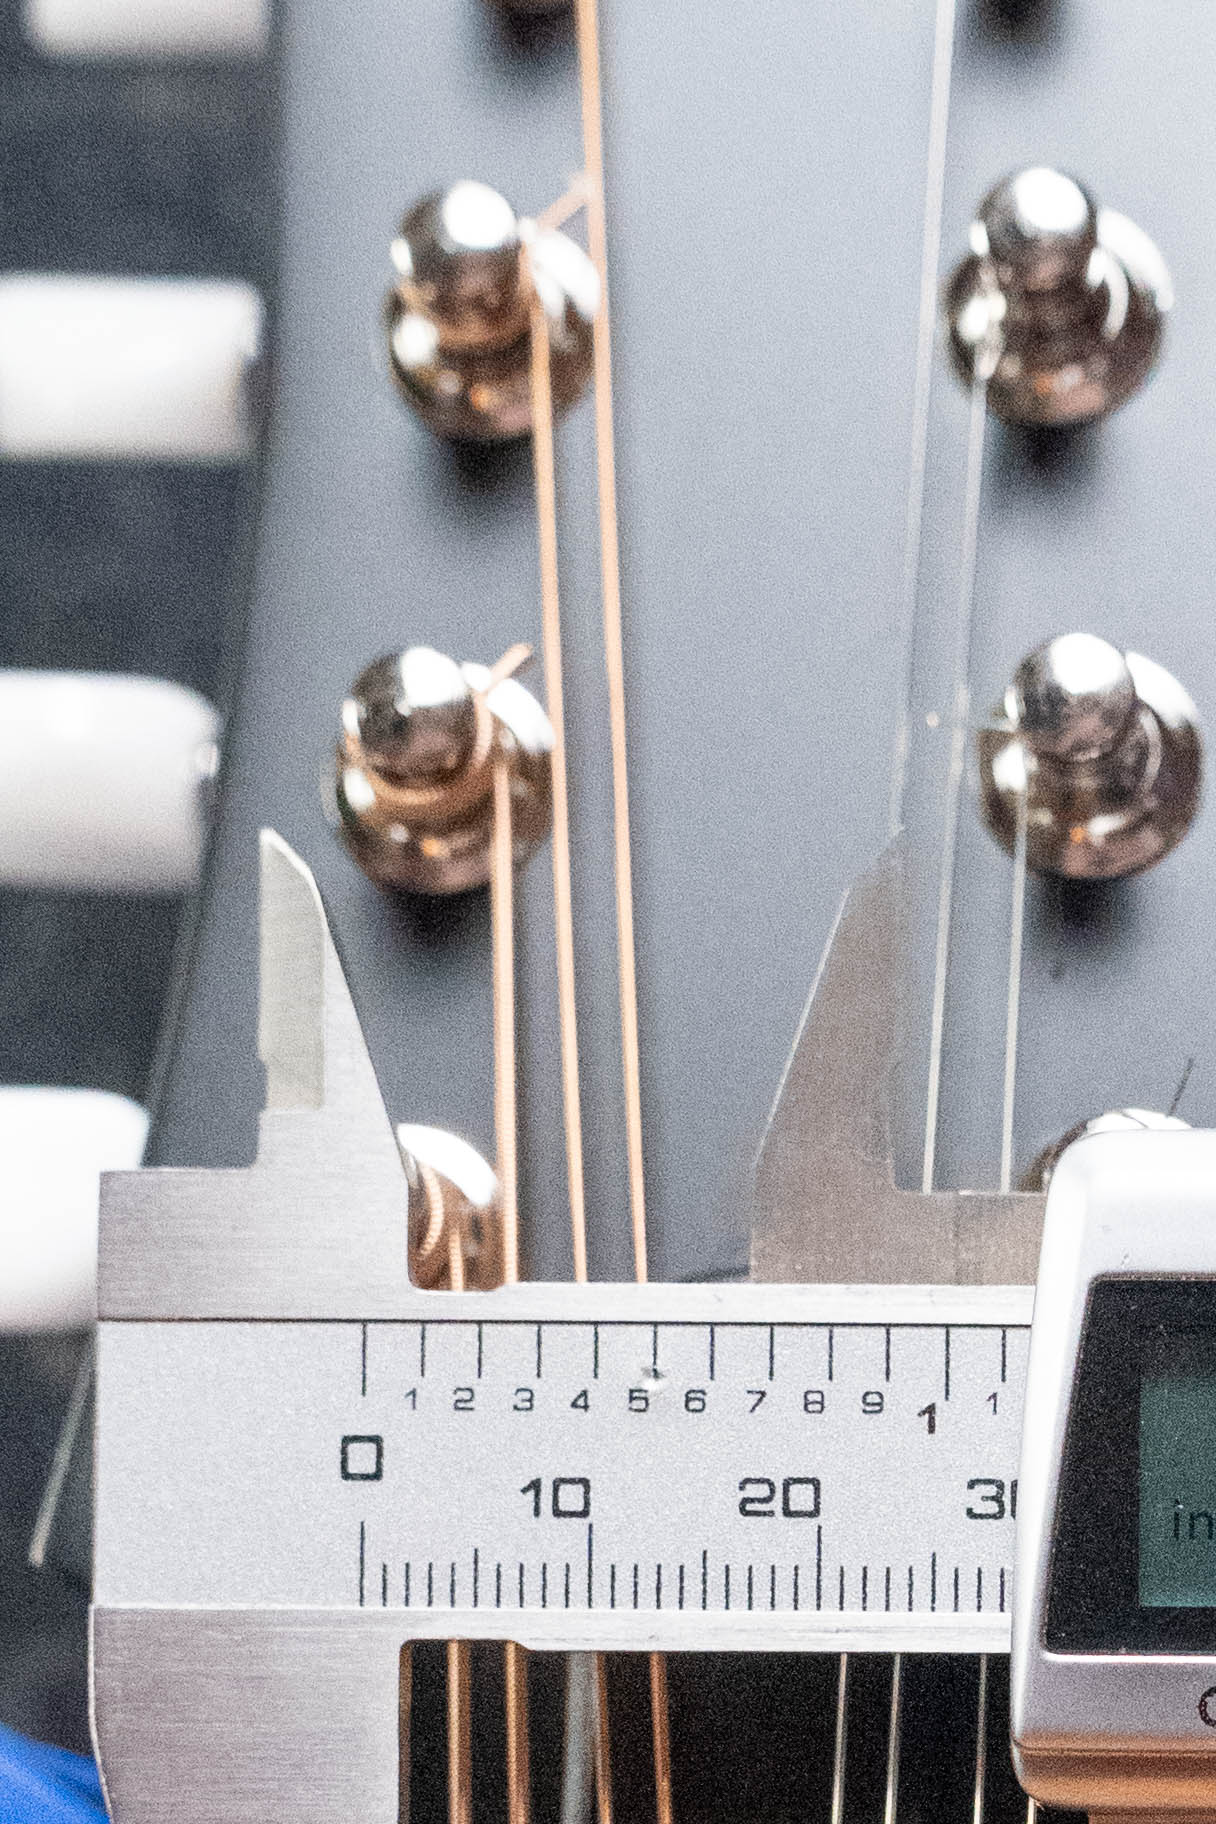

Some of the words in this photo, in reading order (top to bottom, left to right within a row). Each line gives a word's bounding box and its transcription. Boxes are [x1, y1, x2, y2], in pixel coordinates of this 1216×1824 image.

[404, 1388, 419, 1411] 1
[453, 1388, 476, 1411] 2
[513, 1388, 535, 1412] 3
[570, 1389, 591, 1413] 4
[628, 1389, 650, 1413] 5
[684, 1389, 708, 1413] 6
[746, 1389, 768, 1413] 7
[803, 1389, 826, 1414] 8
[861, 1389, 885, 1414] 9
[917, 1403, 937, 1434] 1
[985, 1392, 1000, 1415] 1
[340, 1435, 384, 1481] 0
[519, 1477, 592, 1519] 10
[737, 1477, 821, 1520] 20
[965, 1478, 1018, 1520] 3
[1171, 1501, 1215, 1541] in
